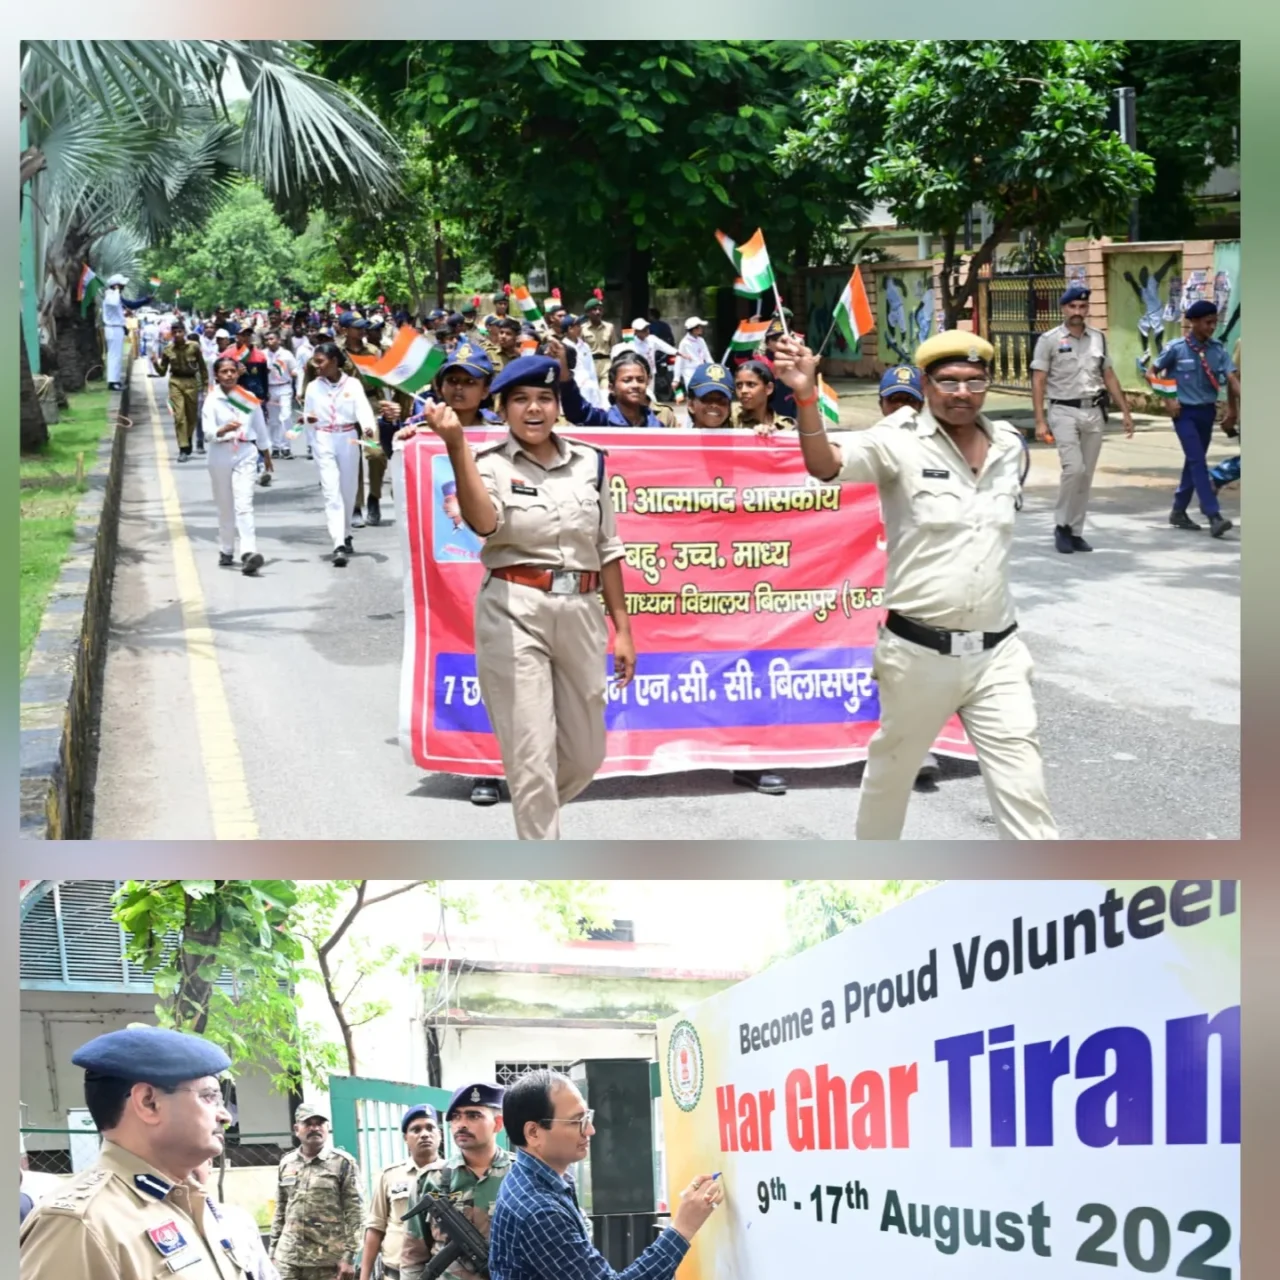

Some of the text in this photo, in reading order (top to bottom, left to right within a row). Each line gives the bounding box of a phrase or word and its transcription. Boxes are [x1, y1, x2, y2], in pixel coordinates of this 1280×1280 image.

[633, 477, 736, 514] आत्मानंद
[742, 478, 841, 513] शासकीय
[732, 540, 791, 568] माध्य
[680, 583, 751, 615] विद्यालय
[754, 582, 838, 622] बिलासपुर
[724, 658, 761, 702] सी.
[768, 657, 875, 712] बिलासपुर
[739, 1006, 813, 1055] Become
[820, 999, 836, 1037] a
[844, 948, 938, 1025] Proud
[716, 1084, 775, 1153] Har
[785, 1061, 918, 1153] Ghar
[757, 1176, 787, 1215] 9th
[810, 1180, 869, 1225] 17th
[879, 1188, 1052, 1258] August
